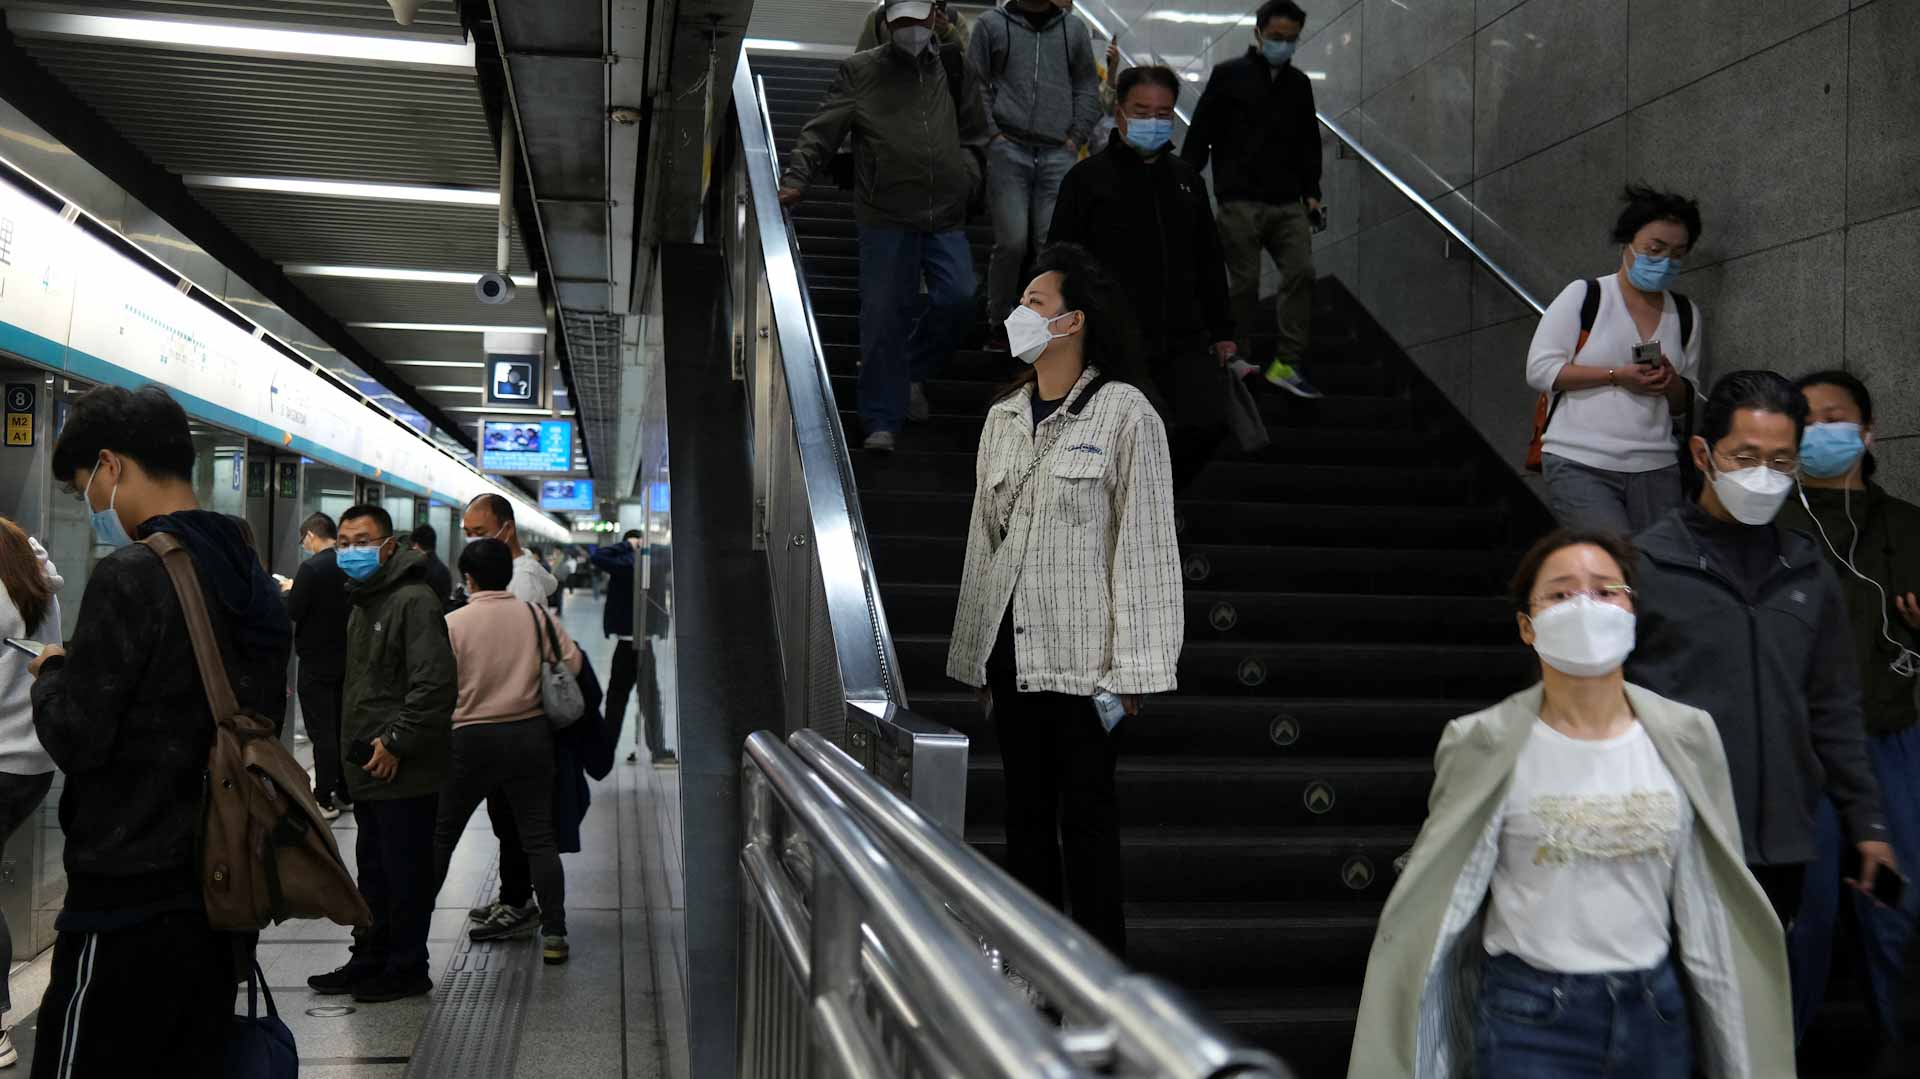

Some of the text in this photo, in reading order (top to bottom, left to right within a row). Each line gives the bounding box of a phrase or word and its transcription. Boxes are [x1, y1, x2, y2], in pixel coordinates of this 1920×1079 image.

[15, 391, 25, 406] 8
[11, 416, 28, 426] M2
[12, 431, 27, 441] A1
